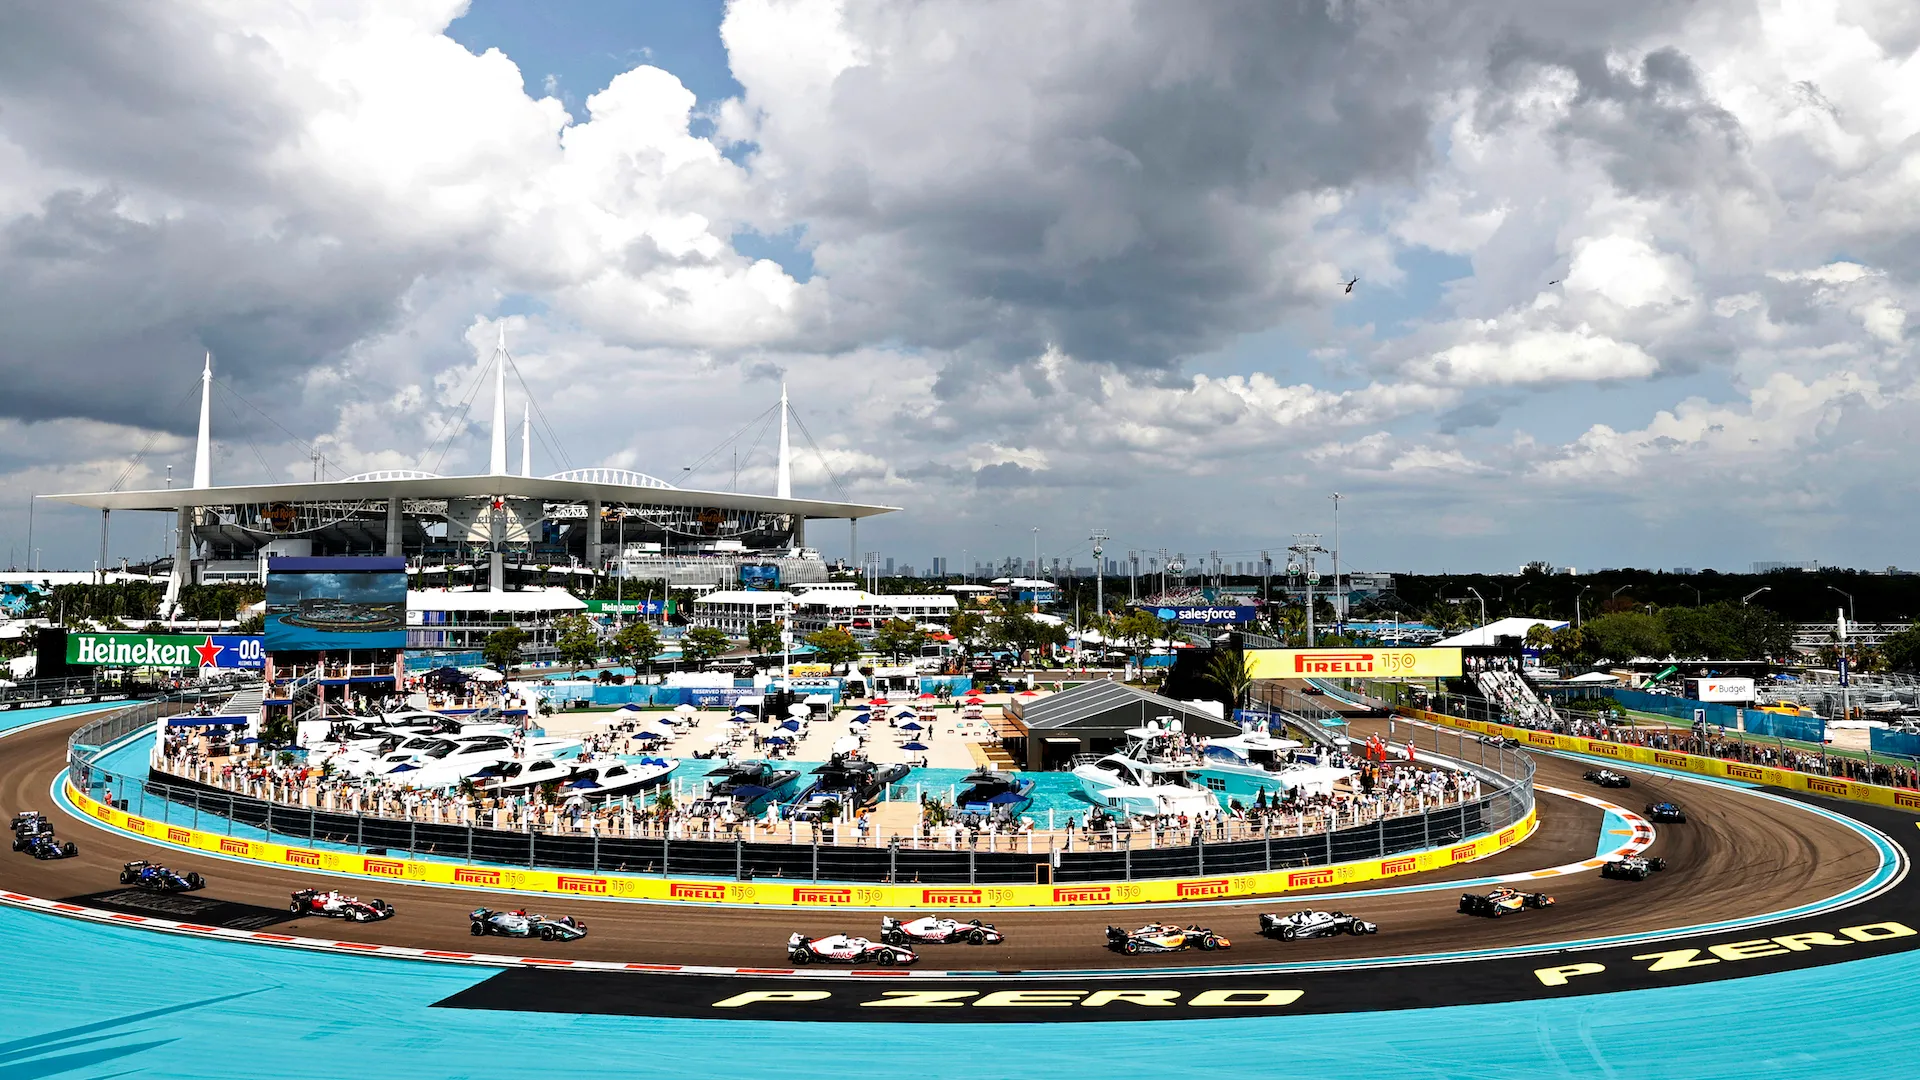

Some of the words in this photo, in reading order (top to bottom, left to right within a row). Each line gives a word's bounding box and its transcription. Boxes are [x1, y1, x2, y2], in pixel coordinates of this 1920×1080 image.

[1179, 607, 1236, 622] salesforce
[77, 636, 191, 665] Heineken
[1295, 654, 1374, 673] PIRELLI
[1381, 653, 1416, 672] 150
[1719, 684, 1747, 695] Budget
[20, 700, 52, 708] #MiamiGP
[60, 697, 92, 705] #MiamiGP
[1588, 742, 1617, 756] PIRELLI
[1655, 752, 1687, 768] PIRELLI
[1727, 764, 1762, 780] PIRELLI
[1807, 778, 1848, 795] PIRELLI
[168, 828, 191, 843] PIRELLI
[220, 839, 249, 855] PIRELLI
[1451, 843, 1476, 861] PIRELLI
[286, 849, 320, 866] PIRELLI
[1381, 857, 1415, 875] PIRELLI
[364, 859, 404, 876] PIRELLI
[407, 863, 426, 877] 150
[455, 868, 500, 885] PIRELLI
[505, 872, 526, 886] 150
[558, 876, 607, 893] PIRELLI
[612, 880, 635, 894] 150
[1288, 869, 1333, 887] PIRELLI
[670, 883, 726, 899] PIRELLI
[731, 886, 755, 900] 150
[793, 888, 851, 903] PIRELLI
[857, 889, 883, 903] 150
[1053, 887, 1111, 902] PIRELLI
[1116, 885, 1141, 900] 150
[1177, 880, 1229, 896] PIRELLI
[1233, 878, 1256, 892] 150
[923, 889, 982, 904] PIRELLI
[988, 889, 1014, 904] 150
[831, 951, 853, 959] HAAS
[1534, 962, 1606, 986] P
[1631, 921, 1918, 972] ZERO
[712, 990, 832, 1007] P
[860, 990, 1305, 1007] ZERO
